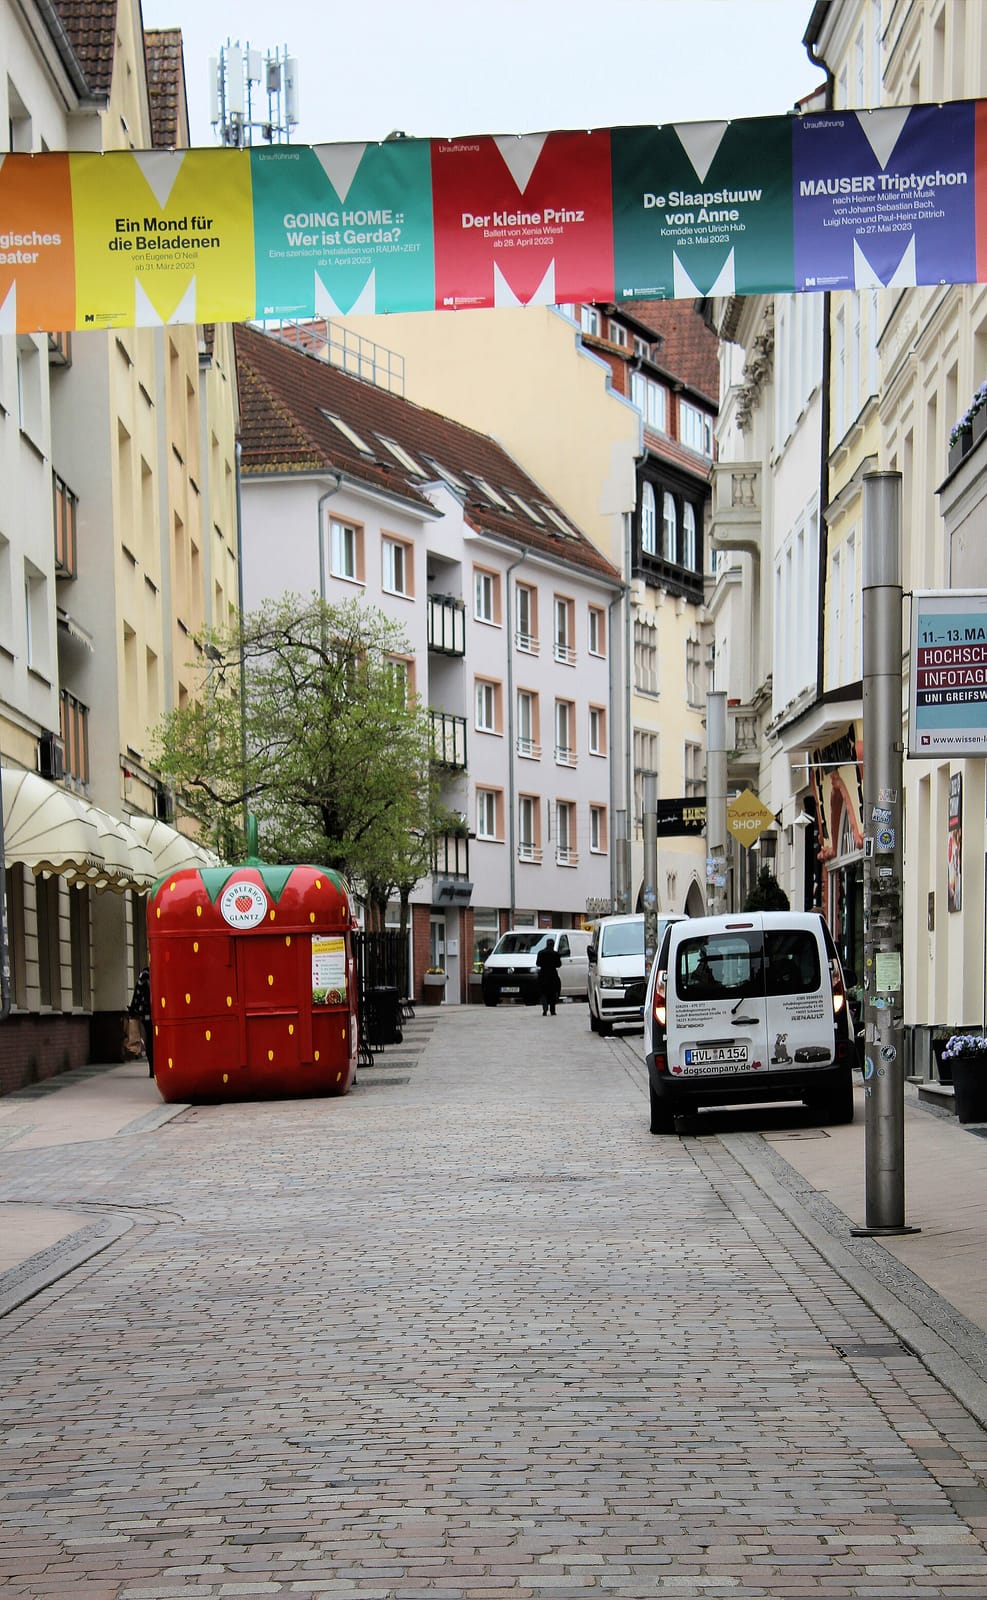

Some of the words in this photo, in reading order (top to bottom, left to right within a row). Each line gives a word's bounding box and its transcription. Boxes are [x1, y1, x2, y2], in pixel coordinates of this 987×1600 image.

[803, 119, 845, 130] Uraufführung
[438, 143, 480, 153] Uraufführung
[800, 176, 875, 197] MAUSER
[878, 170, 968, 192] Triptychon
[643, 193, 666, 209] De
[668, 189, 763, 207] Slaapstuuw
[833, 196, 851, 205] nach
[851, 195, 876, 204] Heiner
[877, 193, 900, 202] Müller
[901, 192, 913, 200] mit
[913, 190, 936, 199] Musik
[833, 208, 847, 216] von
[848, 205, 876, 214] Johann
[876, 203, 913, 212] Sebastian
[914, 201, 935, 211] Bach,
[283, 212, 339, 229] GOING
[342, 210, 392, 226] HOME
[461, 212, 490, 229] Der
[493, 211, 541, 227] kleine
[543, 208, 584, 224] Prinz
[665, 213, 695, 225] von
[696, 209, 739, 224] Anne
[823, 218, 842, 227] Luigi
[842, 217, 862, 226] Nono
[862, 215, 877, 224] und
[877, 212, 918, 223] Paul-Heinz
[918, 210, 945, 220] Dittrich
[115, 218, 141, 233] Ein
[143, 216, 188, 232] Mond
[191, 215, 213, 230] für
[660, 228, 693, 237] Komödie
[707, 225, 729, 234] Ulrich
[730, 224, 746, 232] Hub
[856, 227, 866, 235] ab
[866, 226, 878, 234] 27.
[878, 224, 892, 233] Mai
[892, 223, 913, 232] 2023
[286, 232, 319, 248] Wer
[321, 230, 341, 246] ist
[343, 228, 401, 245] Gerda?
[483, 228, 507, 238] Ballett
[521, 227, 542, 236] Xenia
[542, 226, 564, 235] Wiest
[108, 237, 133, 251] die
[135, 235, 221, 251] Beladenen
[493, 240, 503, 248] ab
[504, 239, 516, 247] 28.
[516, 238, 533, 249] April
[533, 237, 554, 245] 2023
[677, 238, 687, 246] ab
[687, 237, 695, 245] 3.
[695, 236, 709, 244] Mai
[709, 234, 730, 243] 2023
[131, 254, 145, 262] von
[145, 253, 174, 263] Eugene
[174, 251, 199, 261] O'Neill
[269, 249, 286, 258] Eine
[286, 248, 322, 258] szenische
[322, 246, 361, 256] Installation
[375, 244, 421, 254] RAUM+ZEIT
[135, 264, 145, 272] ab
[156, 262, 175, 270] März
[175, 261, 196, 270] 2023
[318, 258, 328, 266] ab
[334, 257, 351, 267] April
[351, 256, 372, 265] 2023
[925, 668, 987, 687] INFOTAG
[925, 692, 943, 704] UNI
[933, 735, 987, 744] www.wissen-l
[732, 819, 762, 830] SHOP
[225, 885, 263, 908] ERDBEERHOF
[229, 914, 259, 922] GLANTZ
[791, 1013, 824, 1021] RENAULT
[691, 1051, 711, 1061] HVL
[718, 1049, 725, 1059] A
[727, 1048, 746, 1059] 154
[683, 1063, 751, 1076] dogscompany.de
